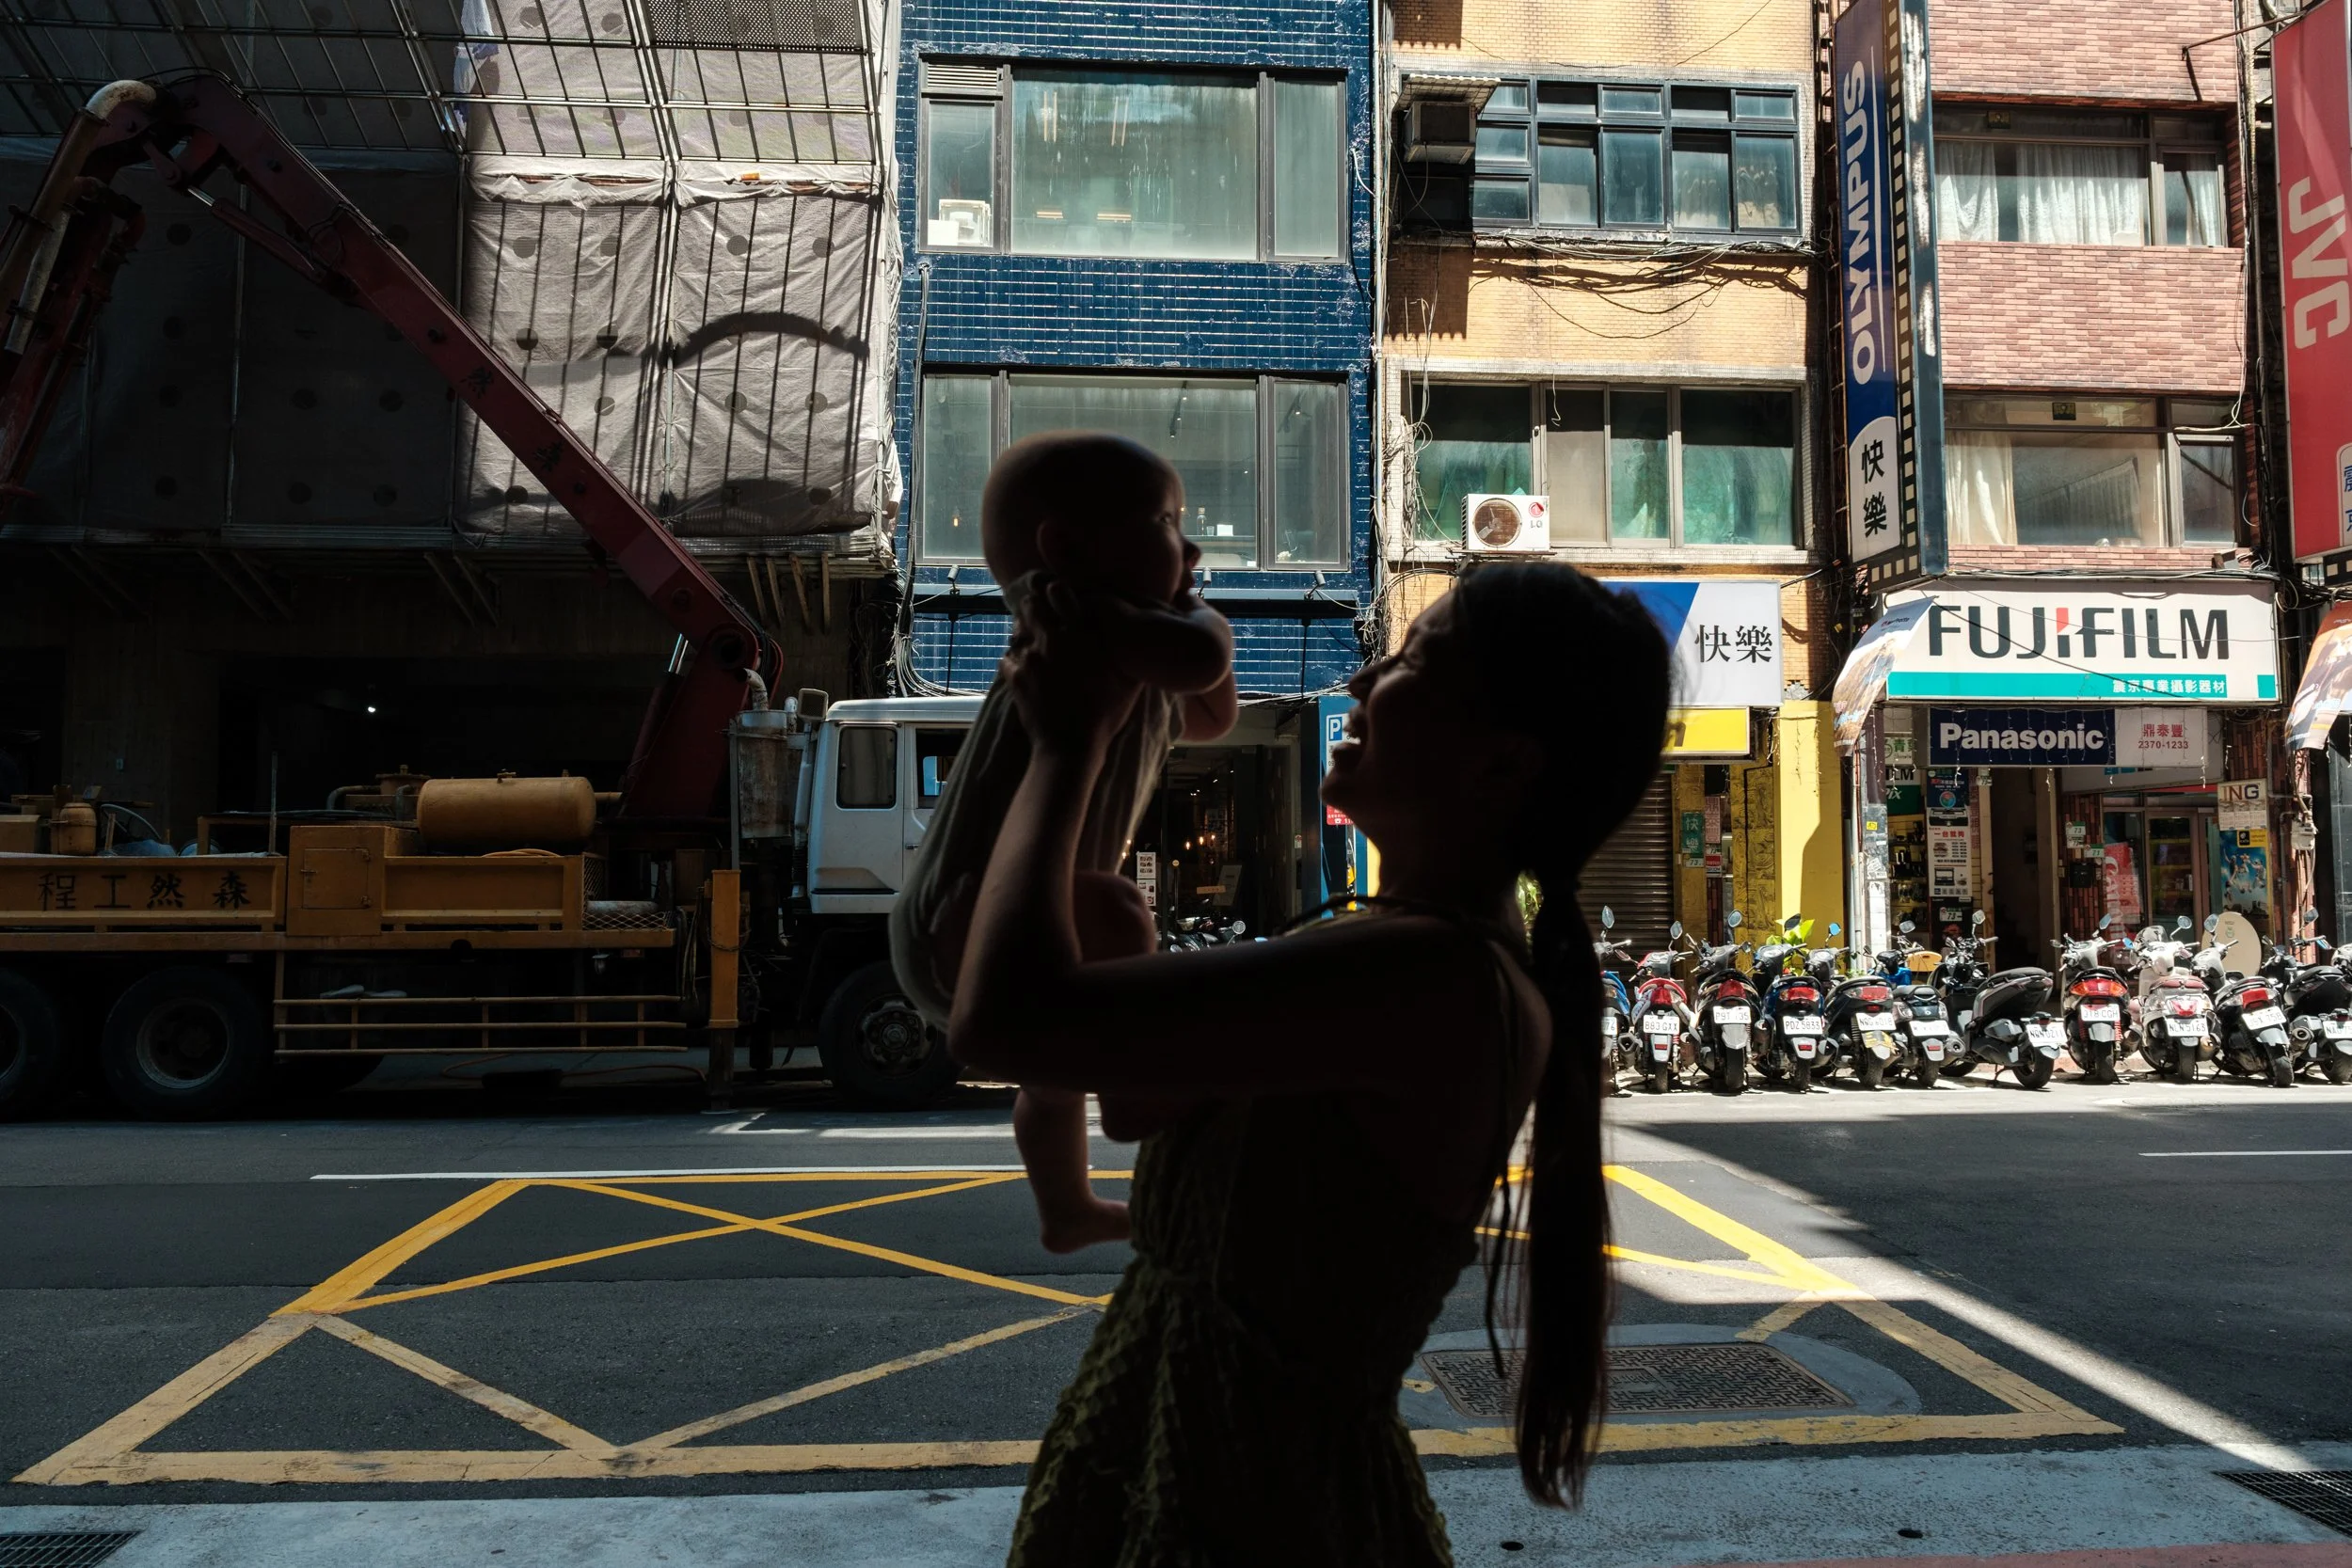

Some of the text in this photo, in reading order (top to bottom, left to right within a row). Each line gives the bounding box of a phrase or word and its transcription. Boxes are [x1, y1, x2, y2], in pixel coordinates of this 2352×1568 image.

[1843, 60, 1875, 385] OLYMPUS
[2288, 176, 2350, 349] JVC
[1861, 438, 1887, 538] 快樂
[1694, 624, 1773, 663] 快樂
[1929, 605, 2229, 660] FUJIFILM
[1329, 719, 1342, 740] P
[1940, 722, 2105, 750] Panasonic
[2137, 740, 2189, 750] 2370-1233
[2143, 723, 2184, 737] 鼎泰豐
